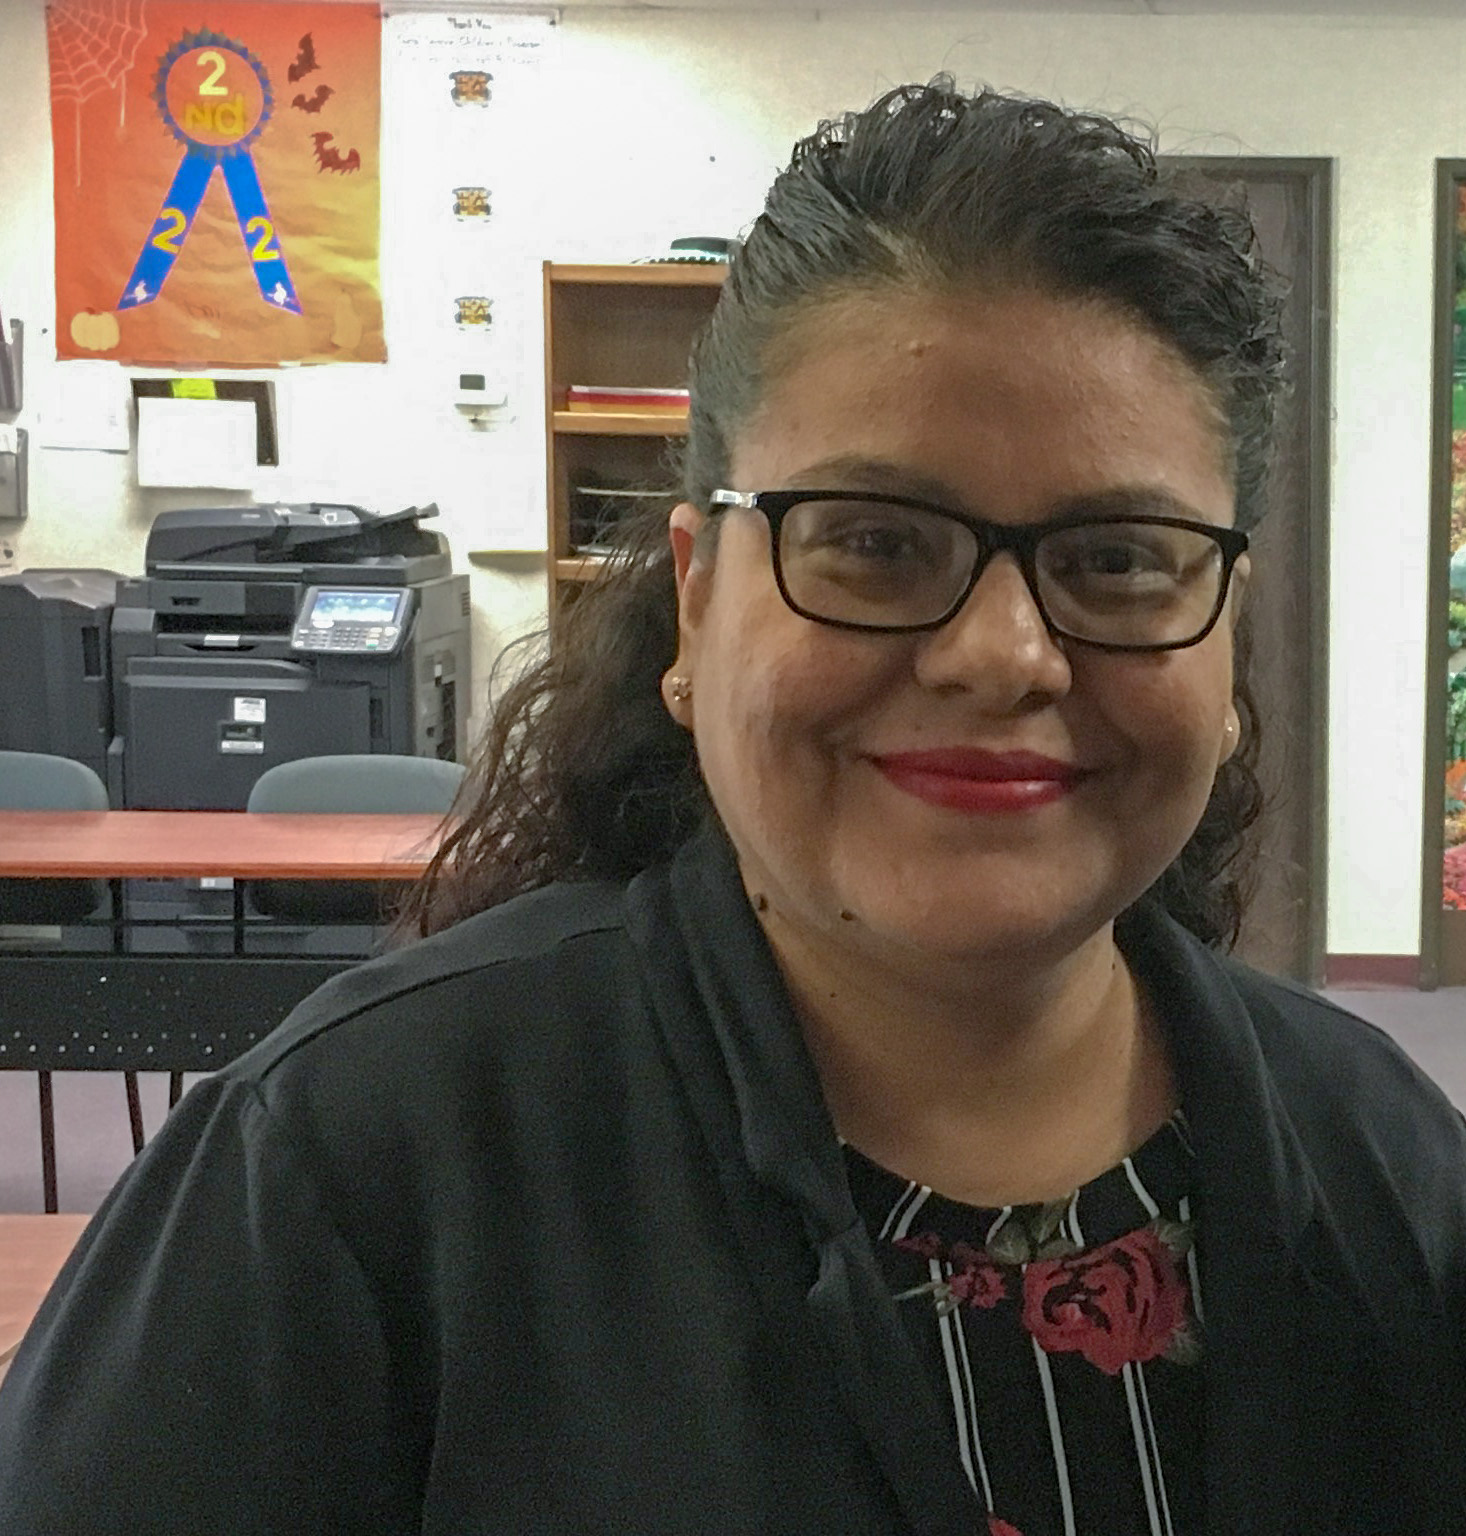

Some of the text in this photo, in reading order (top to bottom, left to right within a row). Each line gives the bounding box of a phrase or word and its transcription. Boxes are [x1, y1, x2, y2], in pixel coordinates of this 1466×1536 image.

[197, 51, 229, 96] 2
[152, 207, 187, 254] 2
[246, 217, 280, 261] 2
